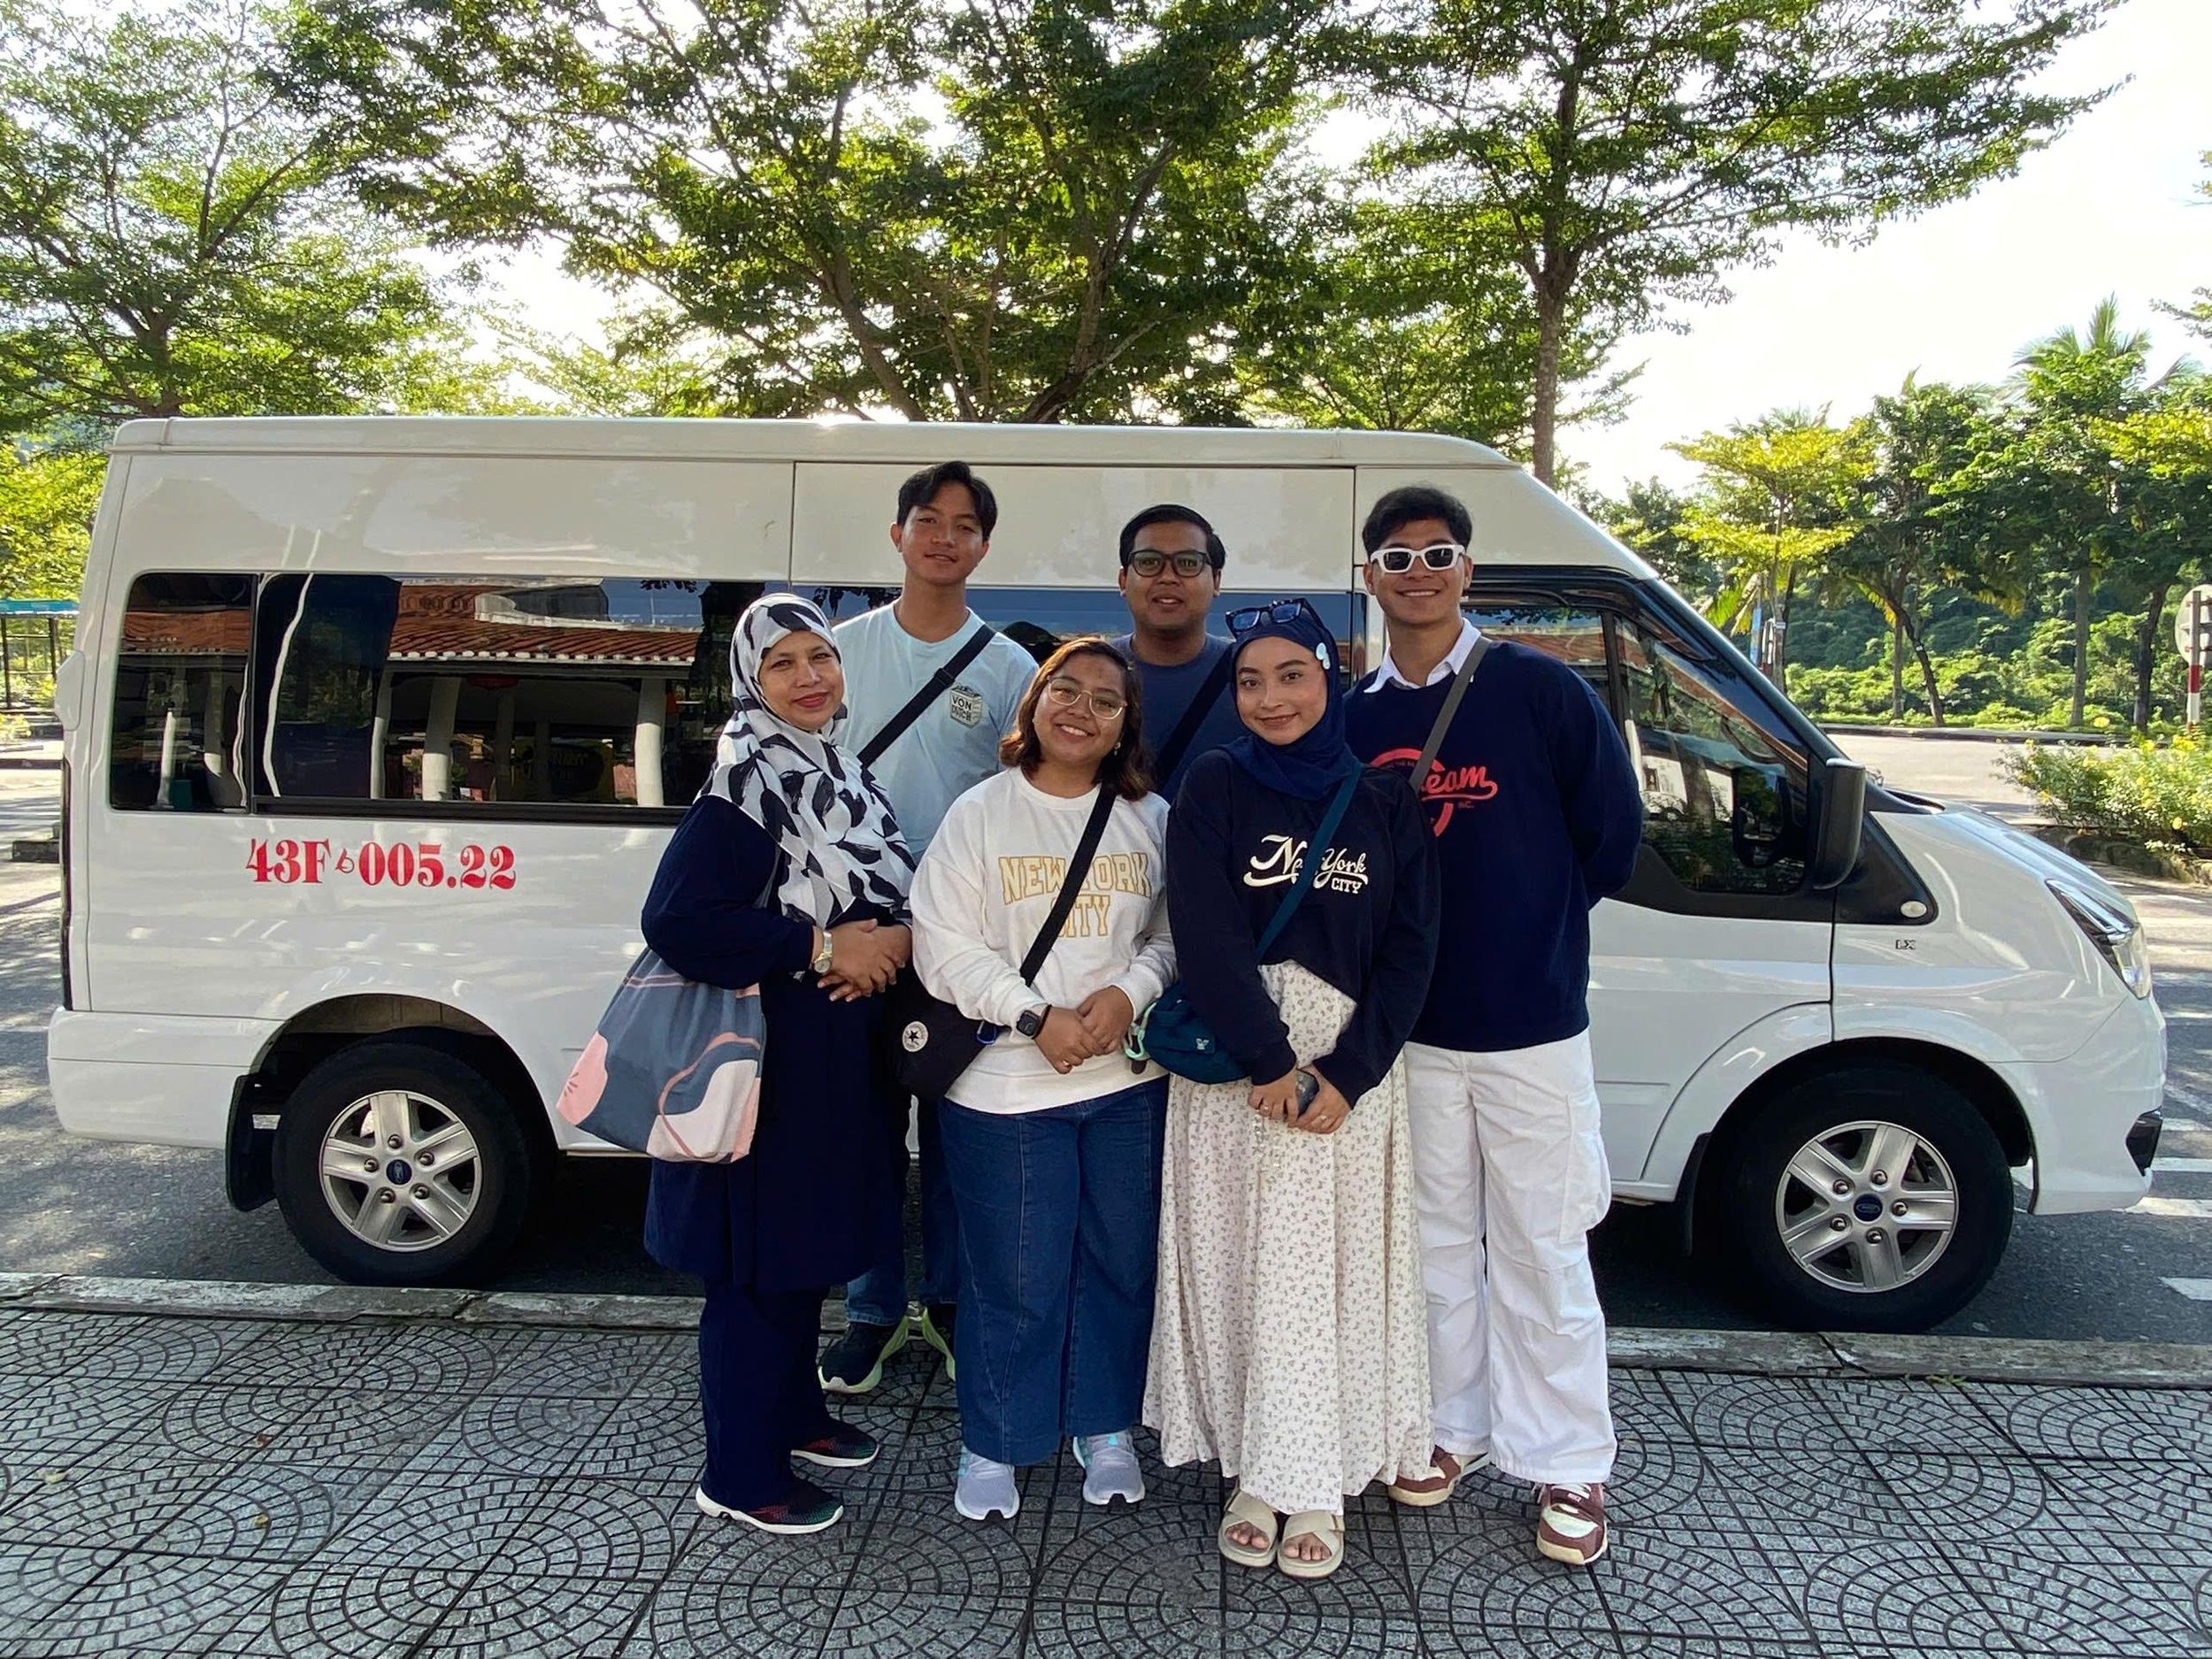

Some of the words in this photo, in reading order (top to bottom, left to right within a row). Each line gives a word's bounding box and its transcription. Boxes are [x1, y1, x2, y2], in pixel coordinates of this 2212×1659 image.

[952, 695, 972, 710] VON
[246, 838, 331, 884] 43F
[358, 841, 516, 889] 005.22
[1080, 852, 1152, 898] ORK
[1243, 834, 1312, 887] Ne
[1313, 848, 1369, 889] York
[1331, 877, 1363, 895] CITY
